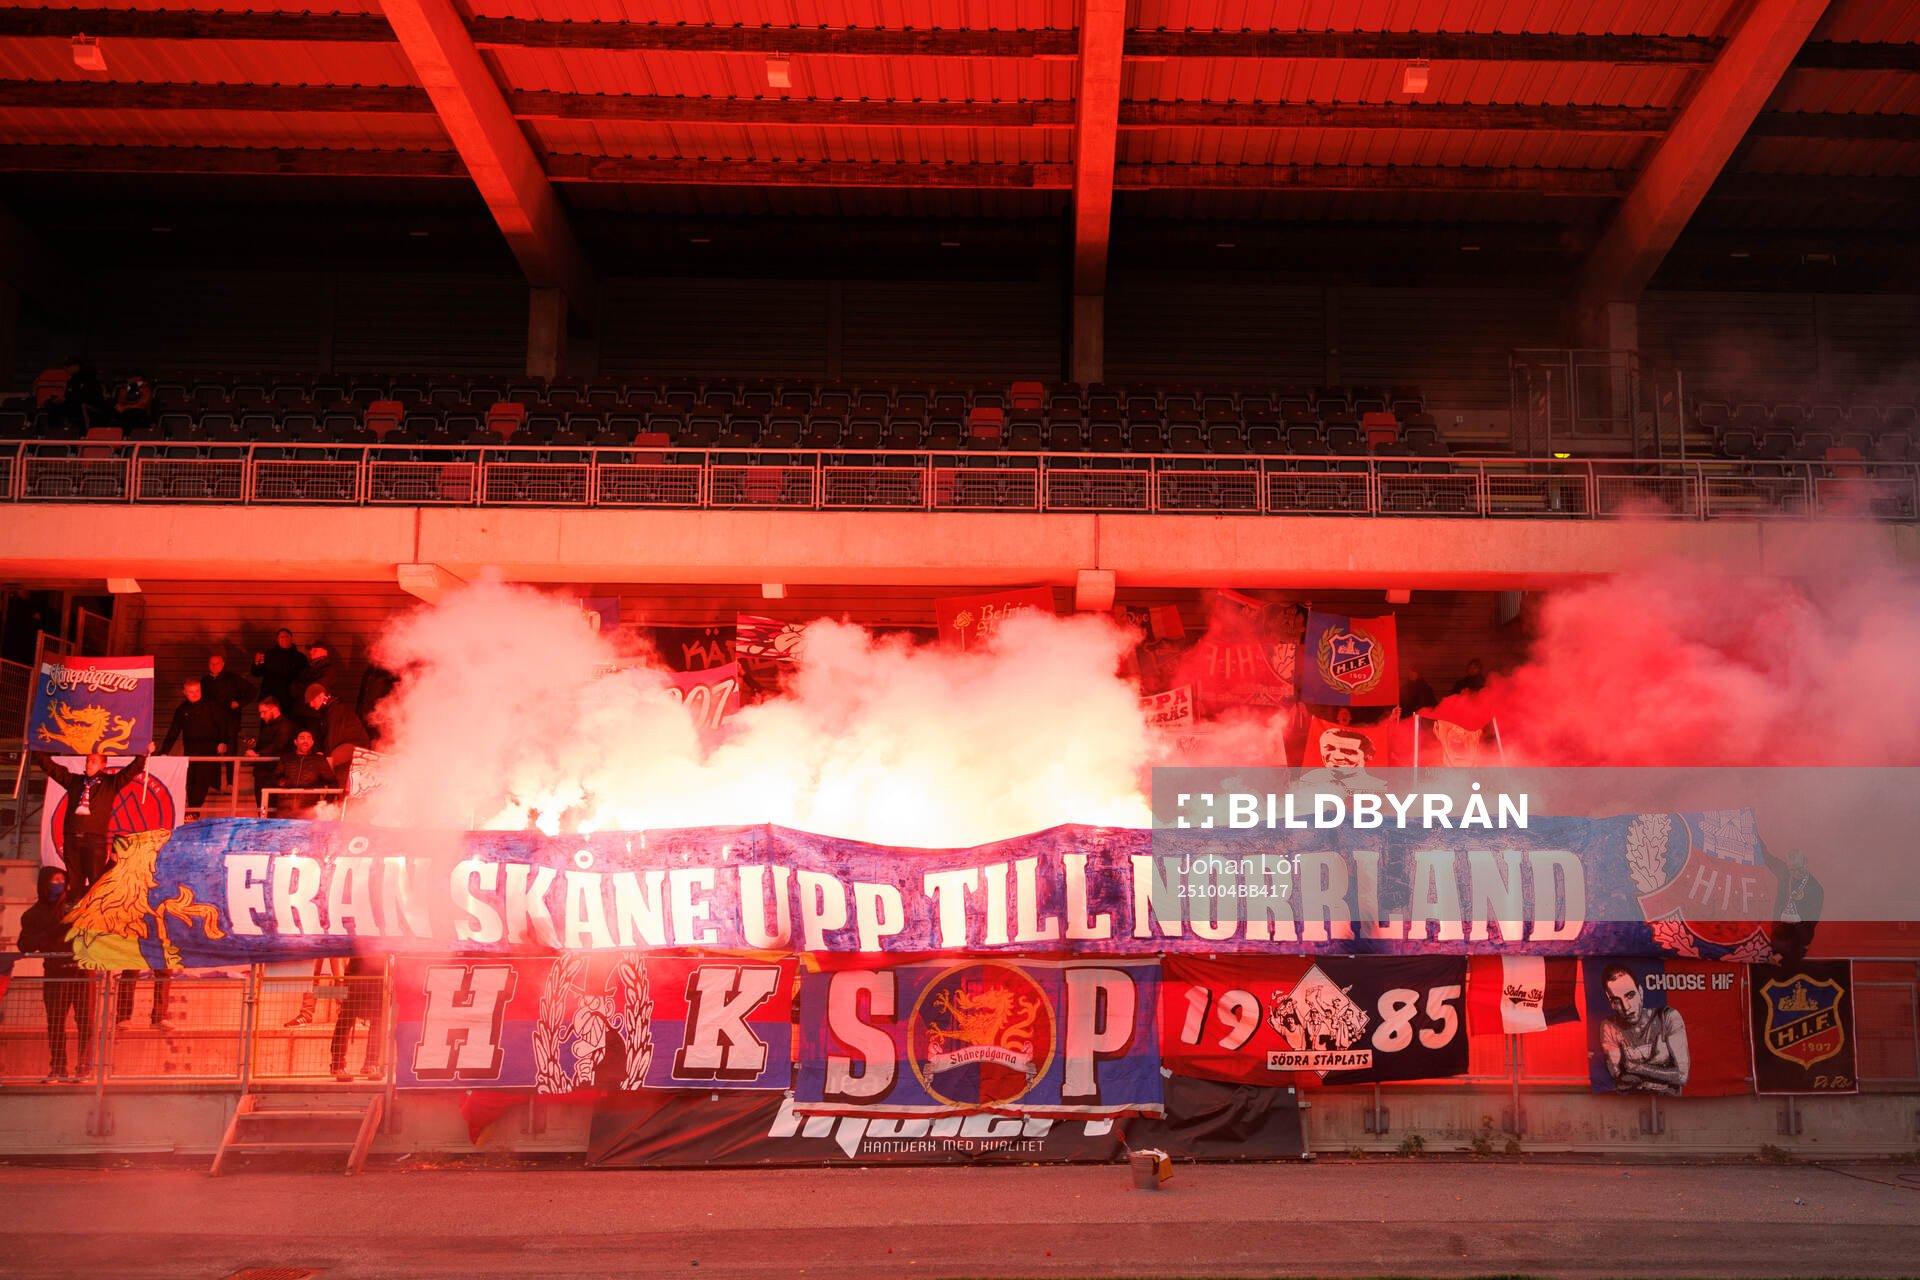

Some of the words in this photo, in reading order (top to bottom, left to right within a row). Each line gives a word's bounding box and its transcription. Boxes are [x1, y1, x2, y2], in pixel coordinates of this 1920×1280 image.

[46, 664, 138, 696] Skånepågarna
[224, 836, 433, 939] FRÅN
[450, 850, 719, 949] SKÅNE
[922, 853, 1112, 949] TILL
[1129, 850, 1586, 942] NORRLAND
[1645, 973, 1706, 991] CHOOSE
[1711, 973, 1735, 991] HIF
[949, 1048, 1018, 1065] Skånepågarna
[1271, 1052, 1309, 1066] SÖDRA
[1313, 1052, 1369, 1066] STÅPLATS
[943, 1139, 975, 1152] MED
